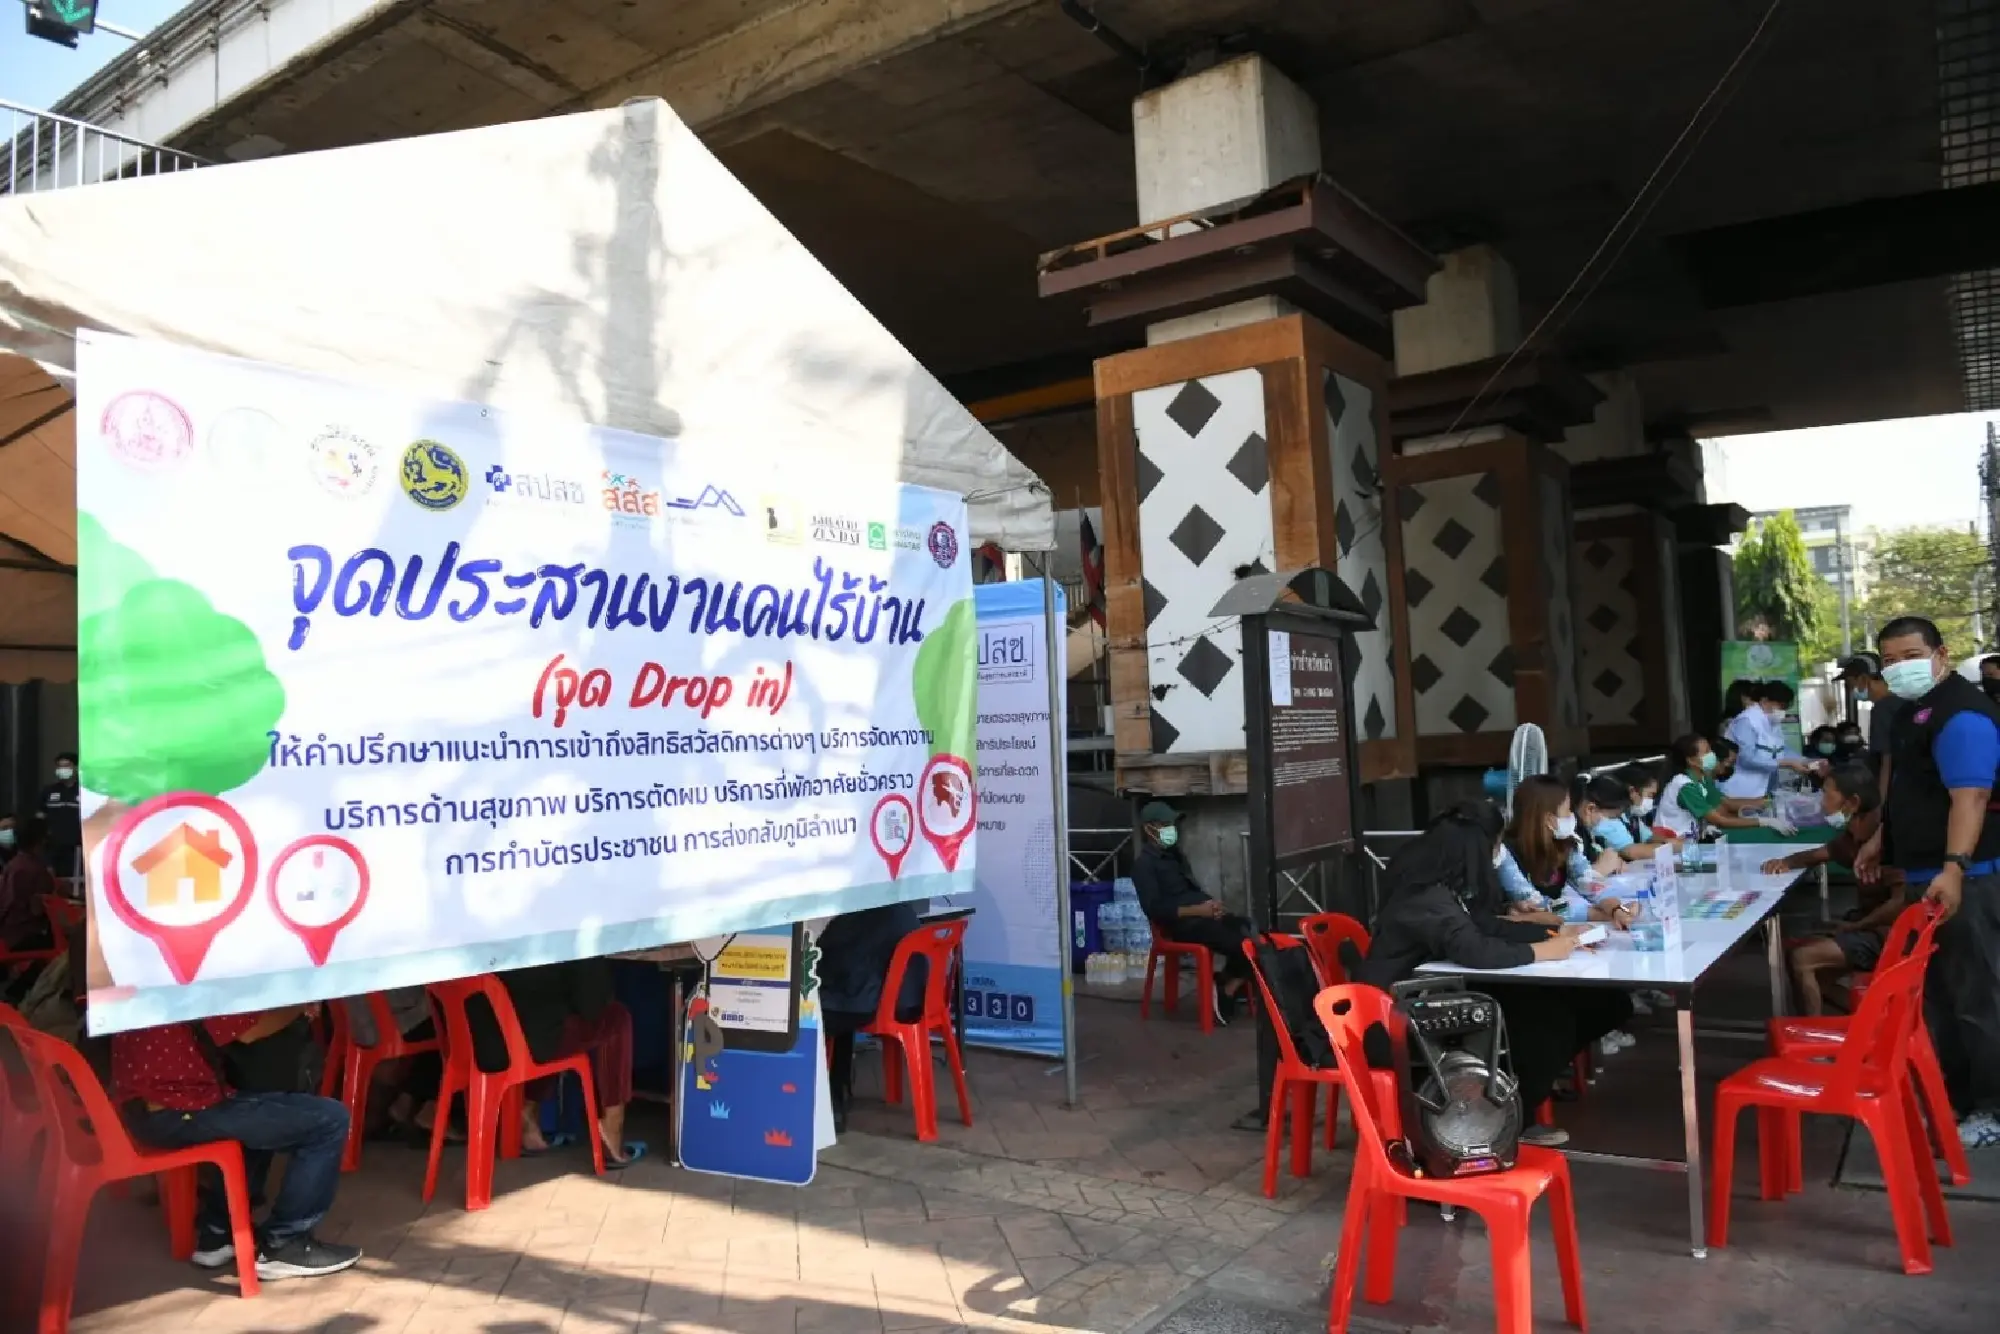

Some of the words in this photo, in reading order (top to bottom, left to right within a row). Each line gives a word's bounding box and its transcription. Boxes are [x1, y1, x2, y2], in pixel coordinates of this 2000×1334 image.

[287, 541, 925, 650] จุดประสานงานคนไร้บ้าน
[532, 653, 612, 728] (จุด
[628, 661, 733, 719] Drop
[747, 660, 793, 715] in)
[821, 727, 935, 750] บริการจัดหางาน
[325, 793, 567, 830] บริการด้านสุขภาพ
[574, 782, 707, 811] บริการตัดผม
[715, 764, 914, 802] บริการที่พักอาศัยชั่วคราว
[446, 835, 677, 874] การทำบัตรประชาชน
[684, 813, 857, 851] การส่งกลับภูมิลำเนา
